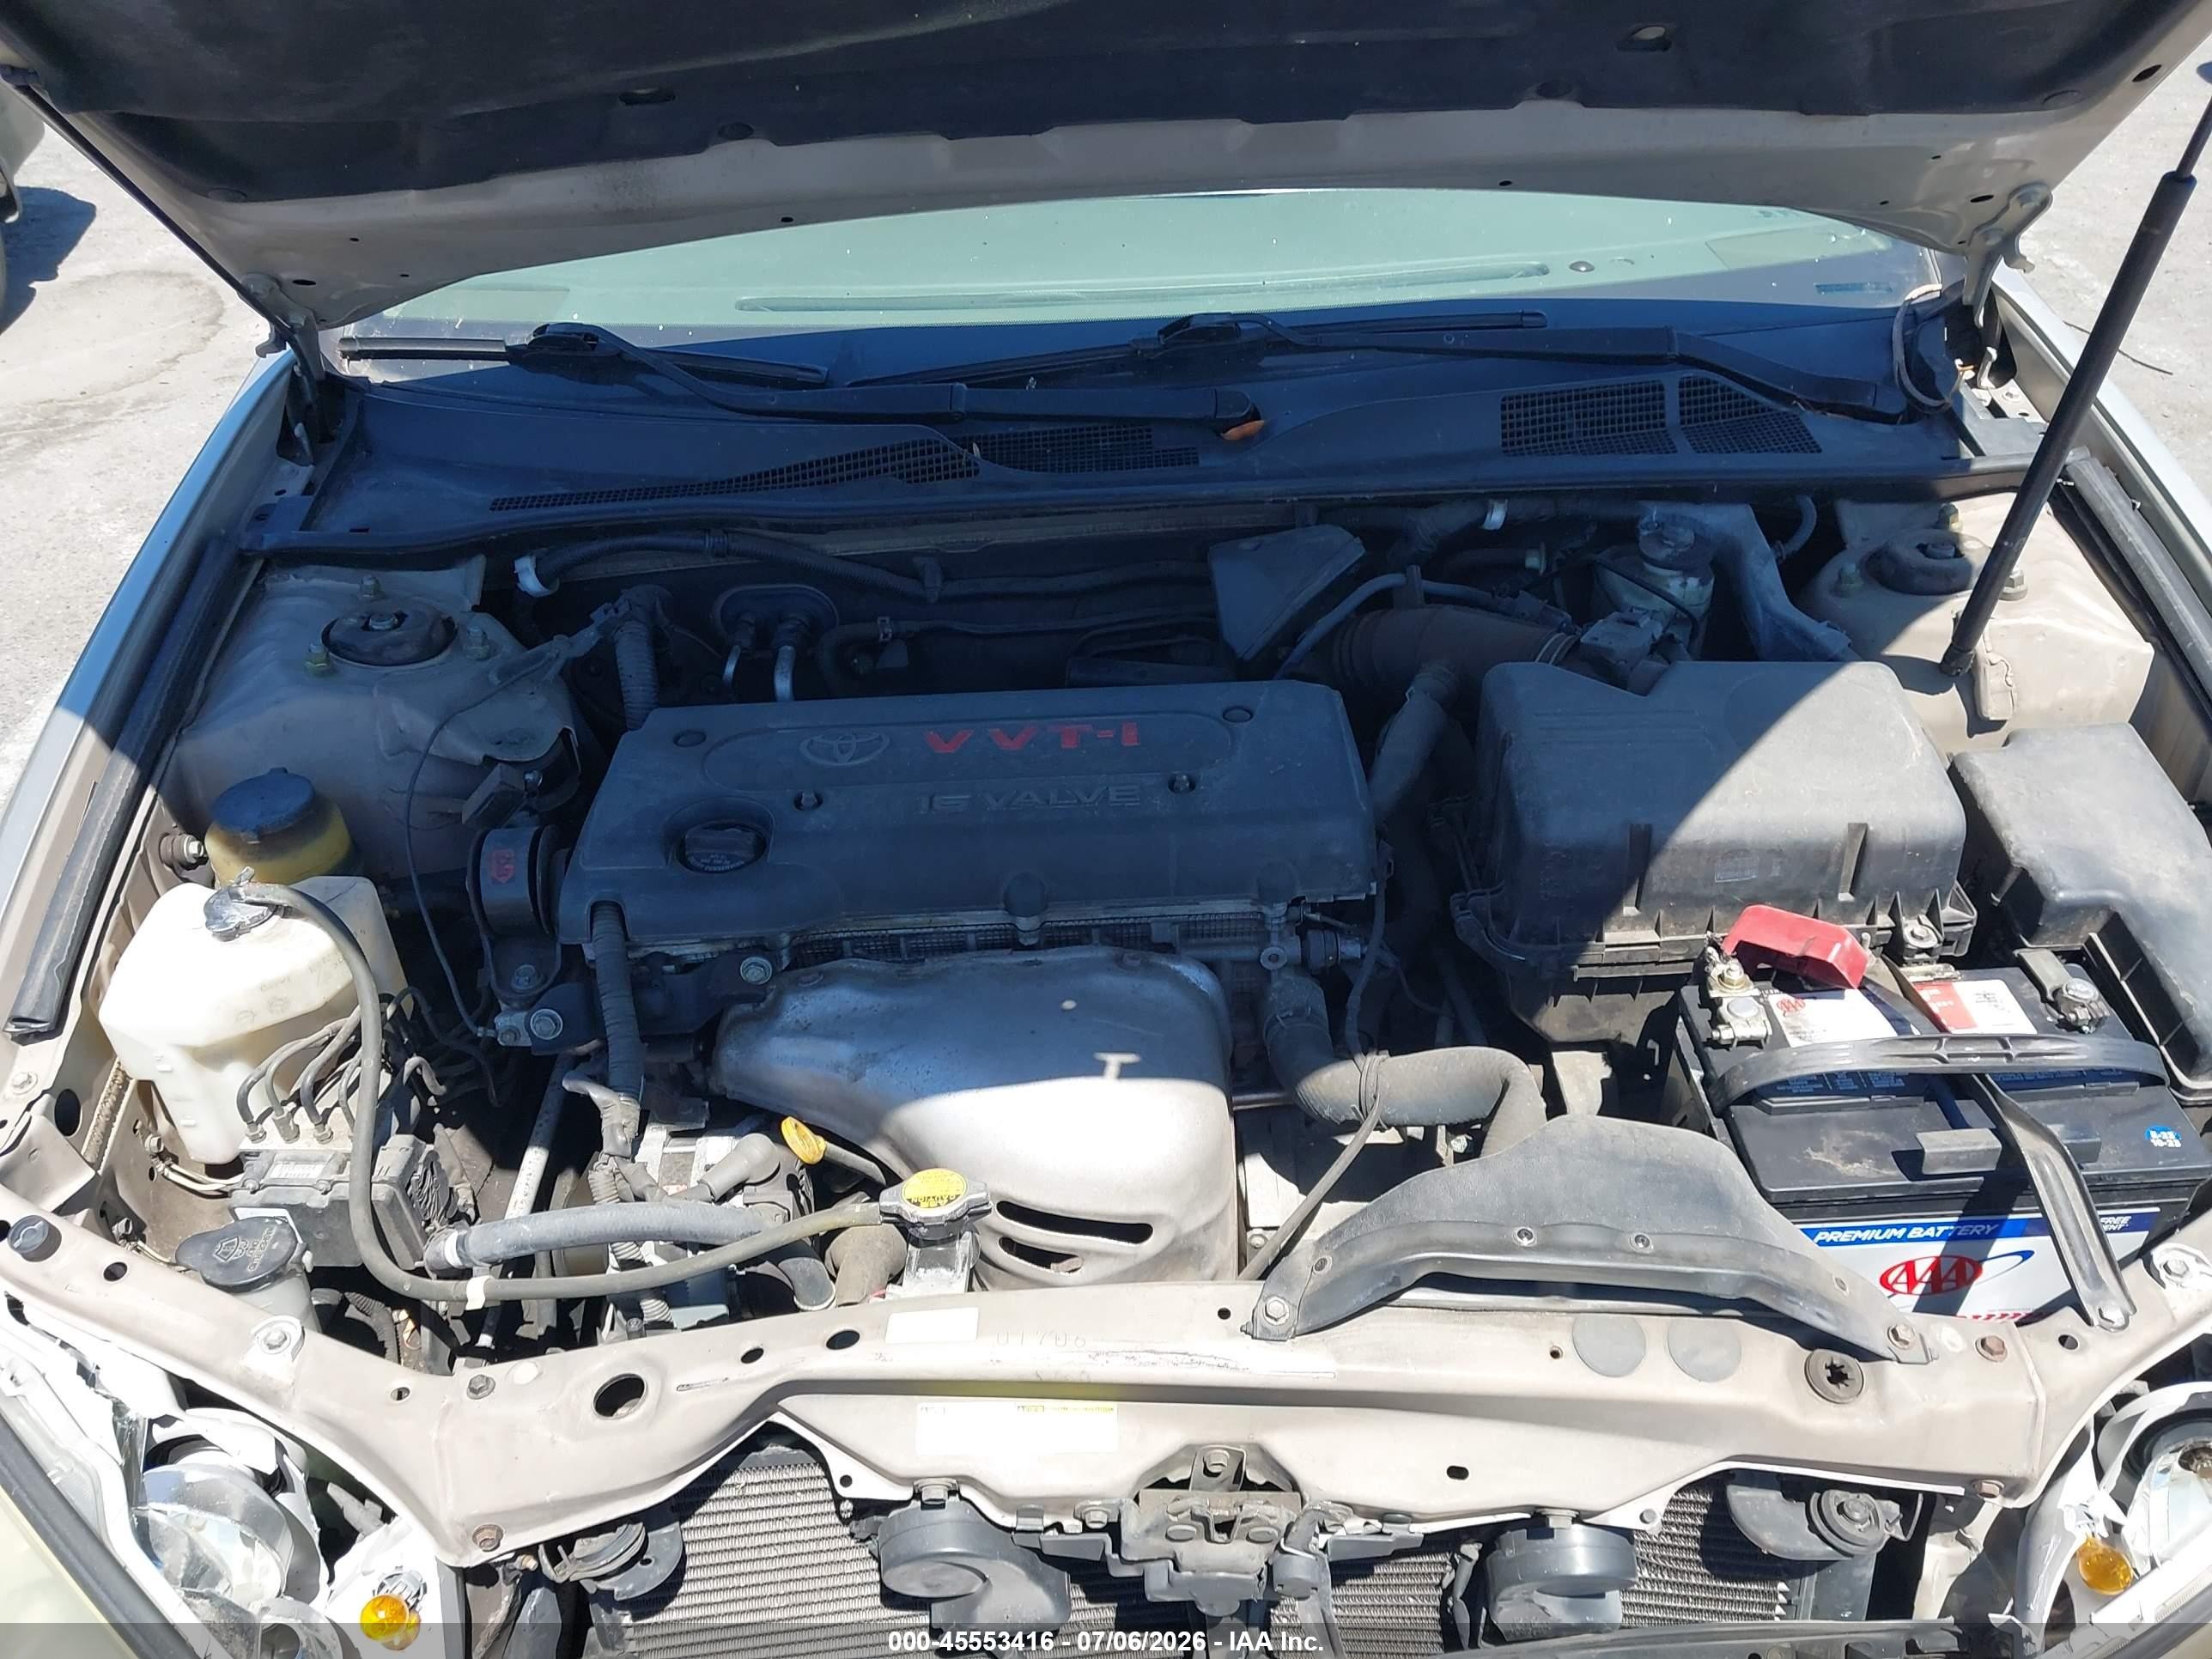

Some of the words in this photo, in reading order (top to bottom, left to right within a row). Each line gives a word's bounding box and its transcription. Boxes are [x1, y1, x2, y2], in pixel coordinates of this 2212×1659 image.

[981, 781, 1142, 811] VALVE
[1813, 1227, 1906, 1243] PREMIUM
[1907, 1224, 1999, 1239] BATTERY
[1885, 1256, 1973, 1295] AAA
